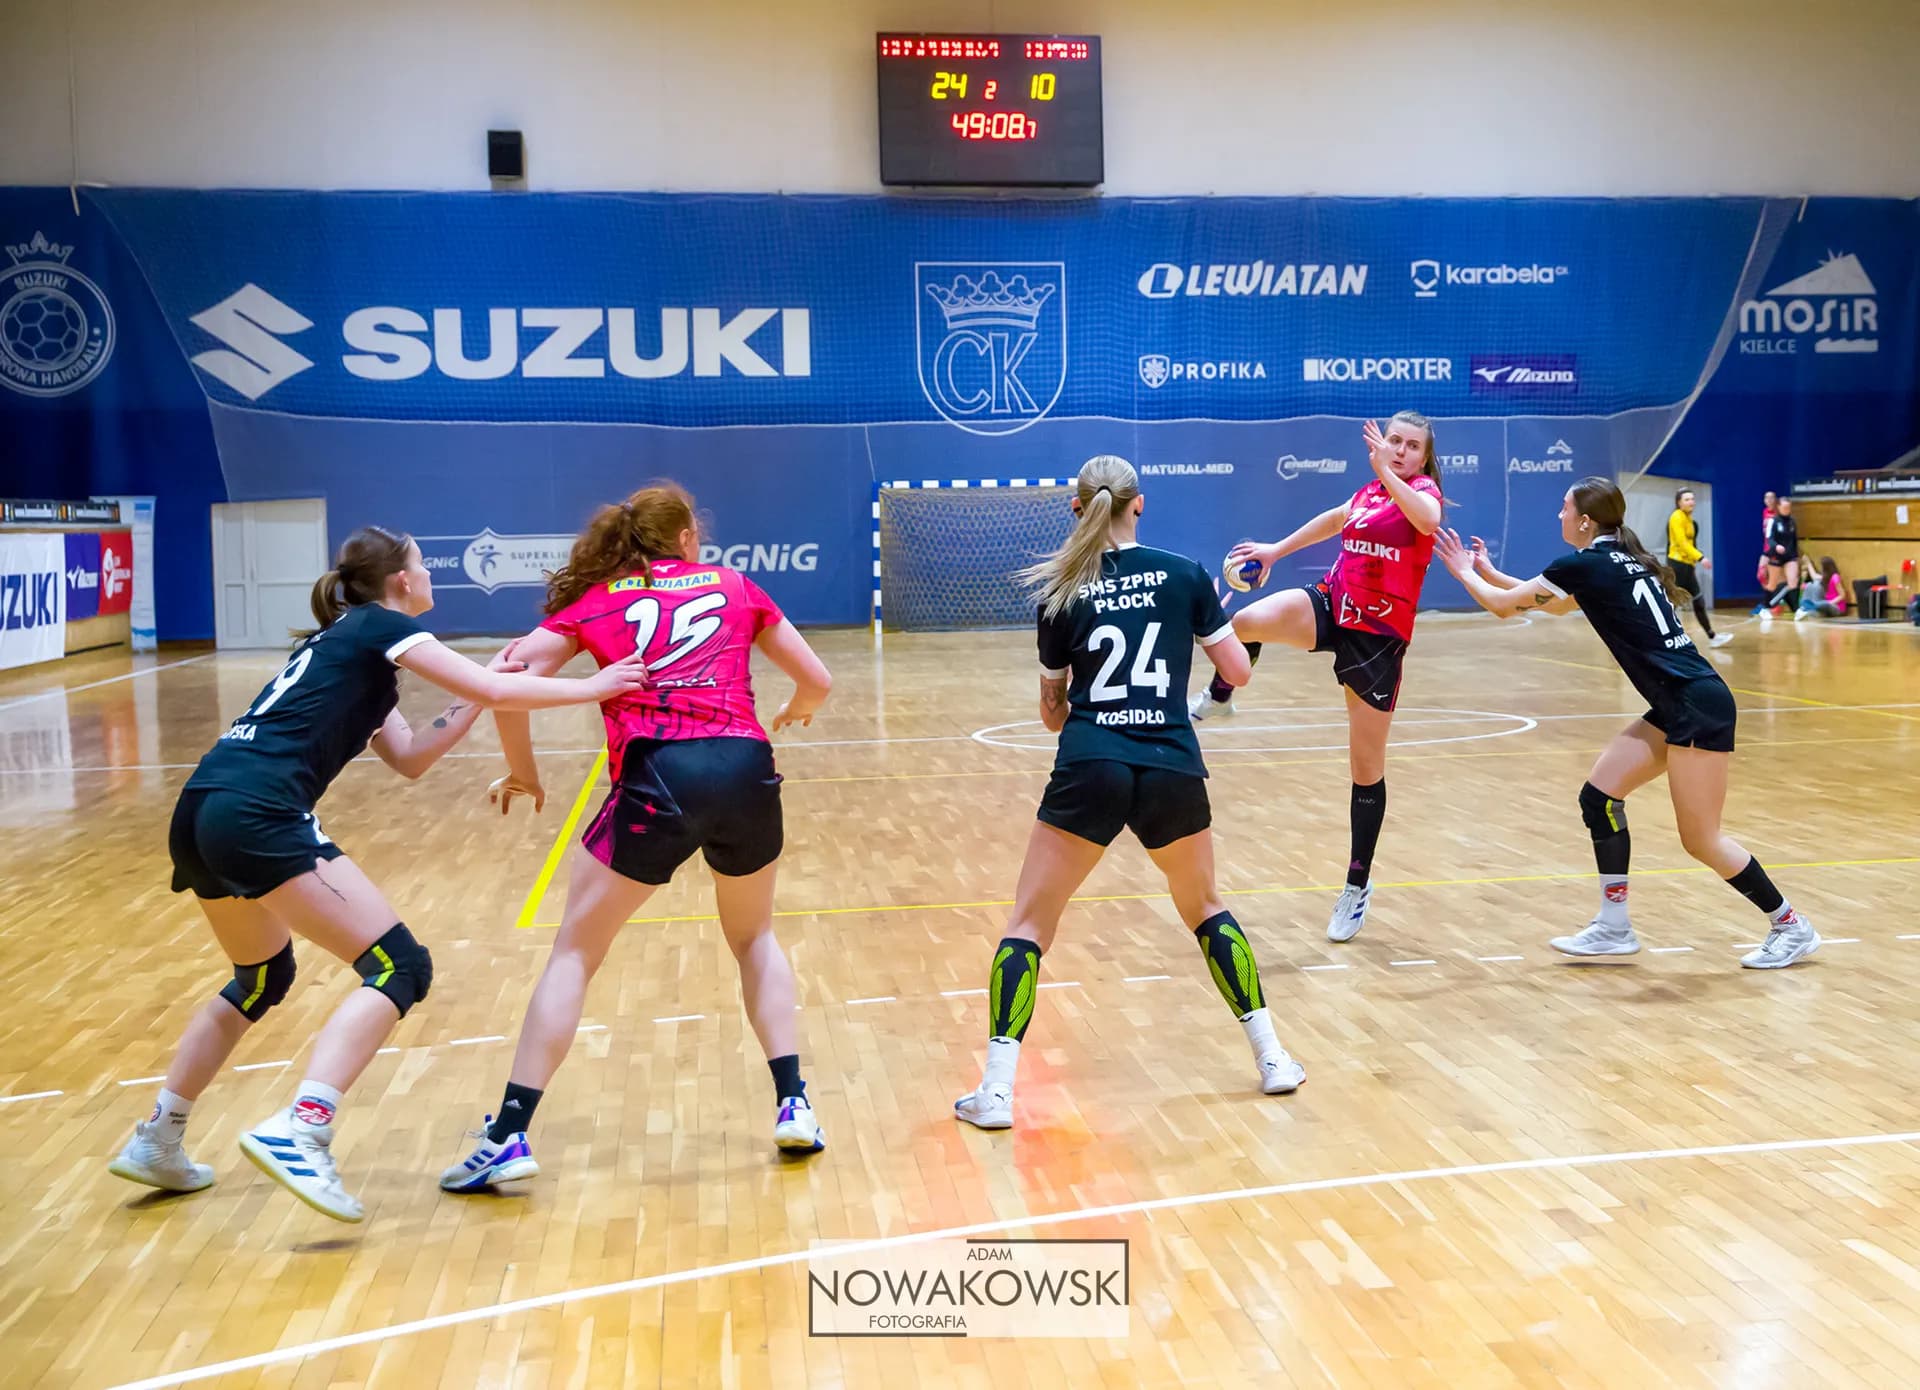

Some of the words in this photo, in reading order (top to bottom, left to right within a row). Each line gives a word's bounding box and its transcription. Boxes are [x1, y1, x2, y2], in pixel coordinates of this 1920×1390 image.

[931, 72, 968, 99] 24
[984, 80, 997, 99] 2
[1030, 73, 1056, 100] 10
[14, 271, 69, 290] SUZUKI
[1185, 260, 1369, 296] LEWIATAN
[1446, 264, 1554, 285] karabela
[342, 305, 811, 380] SUZUKI
[1740, 338, 1798, 355] KIELCE
[41, 339, 102, 385] HANDBALL
[934, 330, 1040, 414] CK
[1172, 362, 1267, 380] PROFIKA
[1318, 357, 1452, 381] KOLPORTER
[1140, 463, 1235, 476] NATURAL-MED
[1435, 455, 1480, 466] TOR
[698, 543, 819, 572] PGNiG
[1343, 538, 1401, 563] SUZUKI
[422, 556, 459, 570] GNiG
[636, 573, 713, 588] LWIATAN
[1078, 577, 1117, 599] SMS
[1119, 570, 1168, 592] ZPRP
[1094, 592, 1157, 614] PŁOCK
[625, 592, 728, 672] 15
[1088, 622, 1171, 702] 24
[1095, 708, 1166, 725] KOSIDŁO
